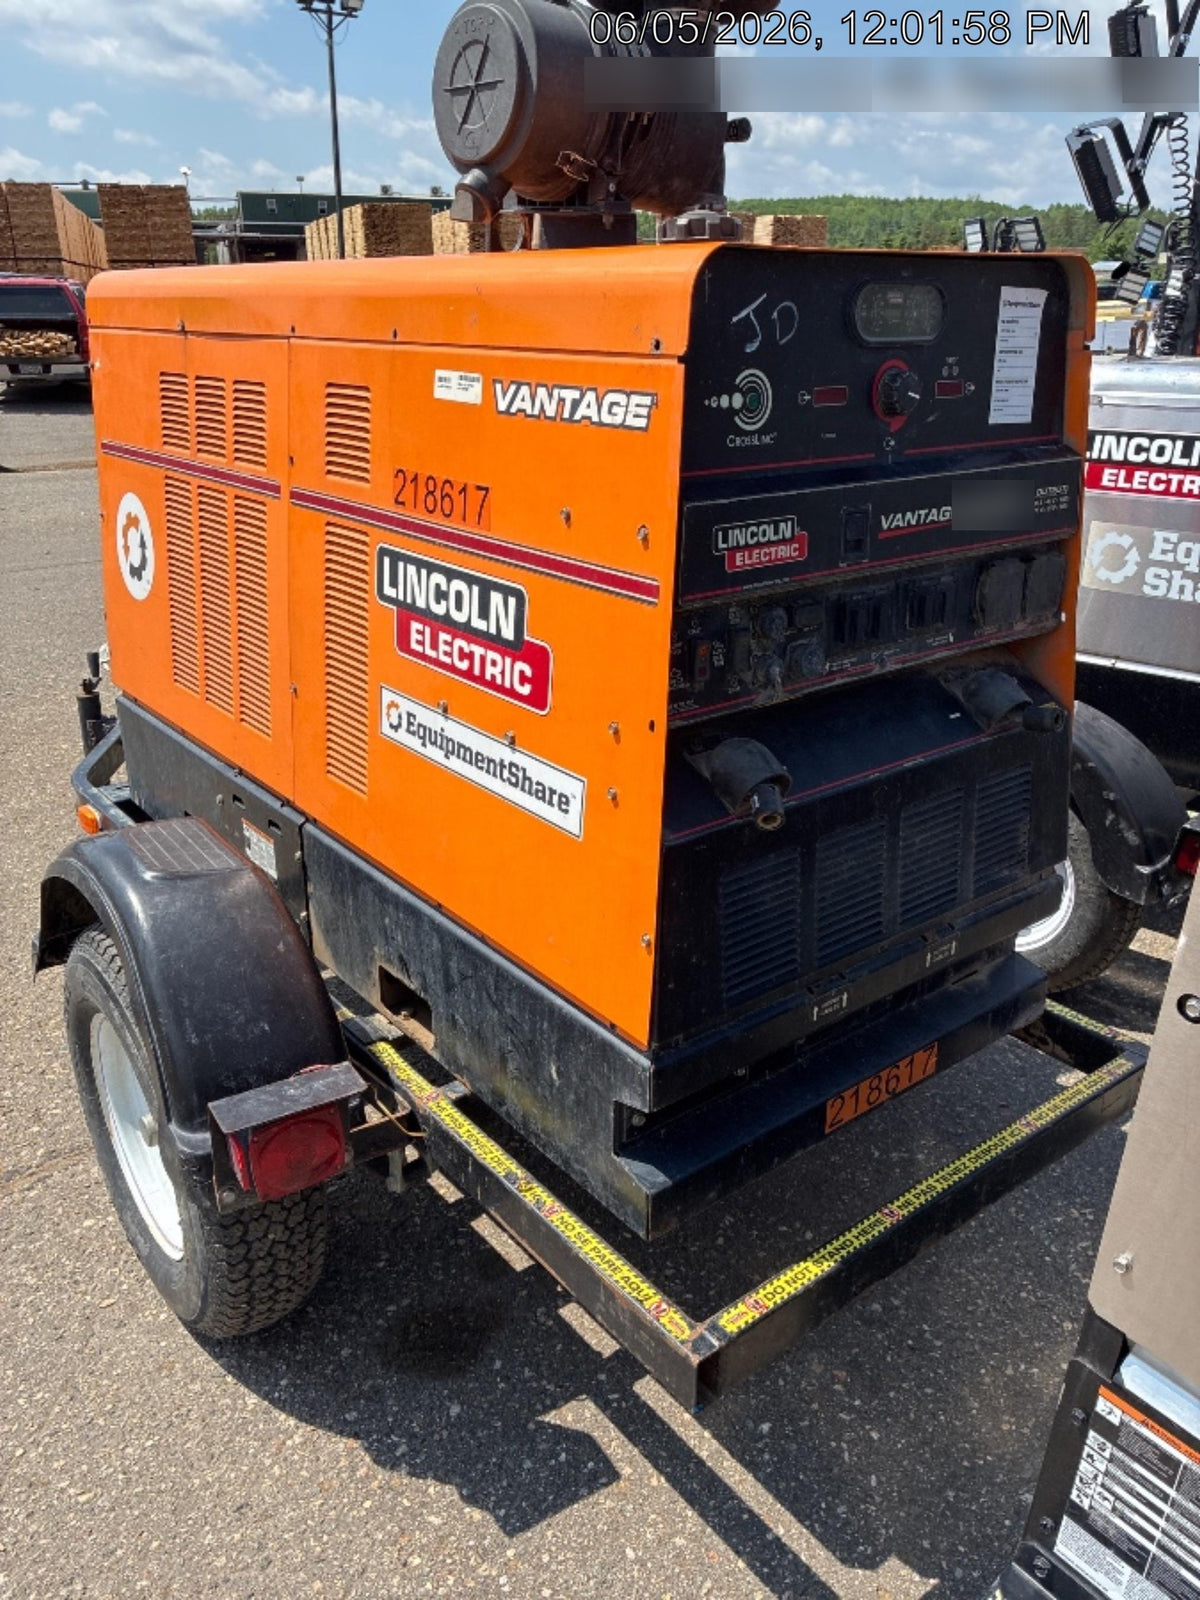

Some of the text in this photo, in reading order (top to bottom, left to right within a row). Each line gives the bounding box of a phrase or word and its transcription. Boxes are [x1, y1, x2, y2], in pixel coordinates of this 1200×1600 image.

[493, 379, 655, 432] VANTAGE
[1085, 434, 1200, 467] INCOL
[394, 468, 490, 527] 218617
[717, 520, 793, 549] LINCOLN
[734, 543, 800, 566] ELECTRIC
[382, 555, 517, 641] LINCOLN
[409, 620, 533, 696] ELECTRIC
[404, 710, 571, 815] EquipmentShare
[828, 1043, 936, 1129] 218617
[897, 1199, 915, 1212] NE
[915, 1183, 937, 1201] PAS
[937, 1161, 969, 1186] TENEZ
[967, 1136, 1008, 1165] DEBOUT
[556, 1215, 575, 1232] NO
[574, 1231, 592, 1246] SE
[589, 1245, 623, 1275] PARE
[763, 1217, 884, 1302] DO NOT STAND HERE
